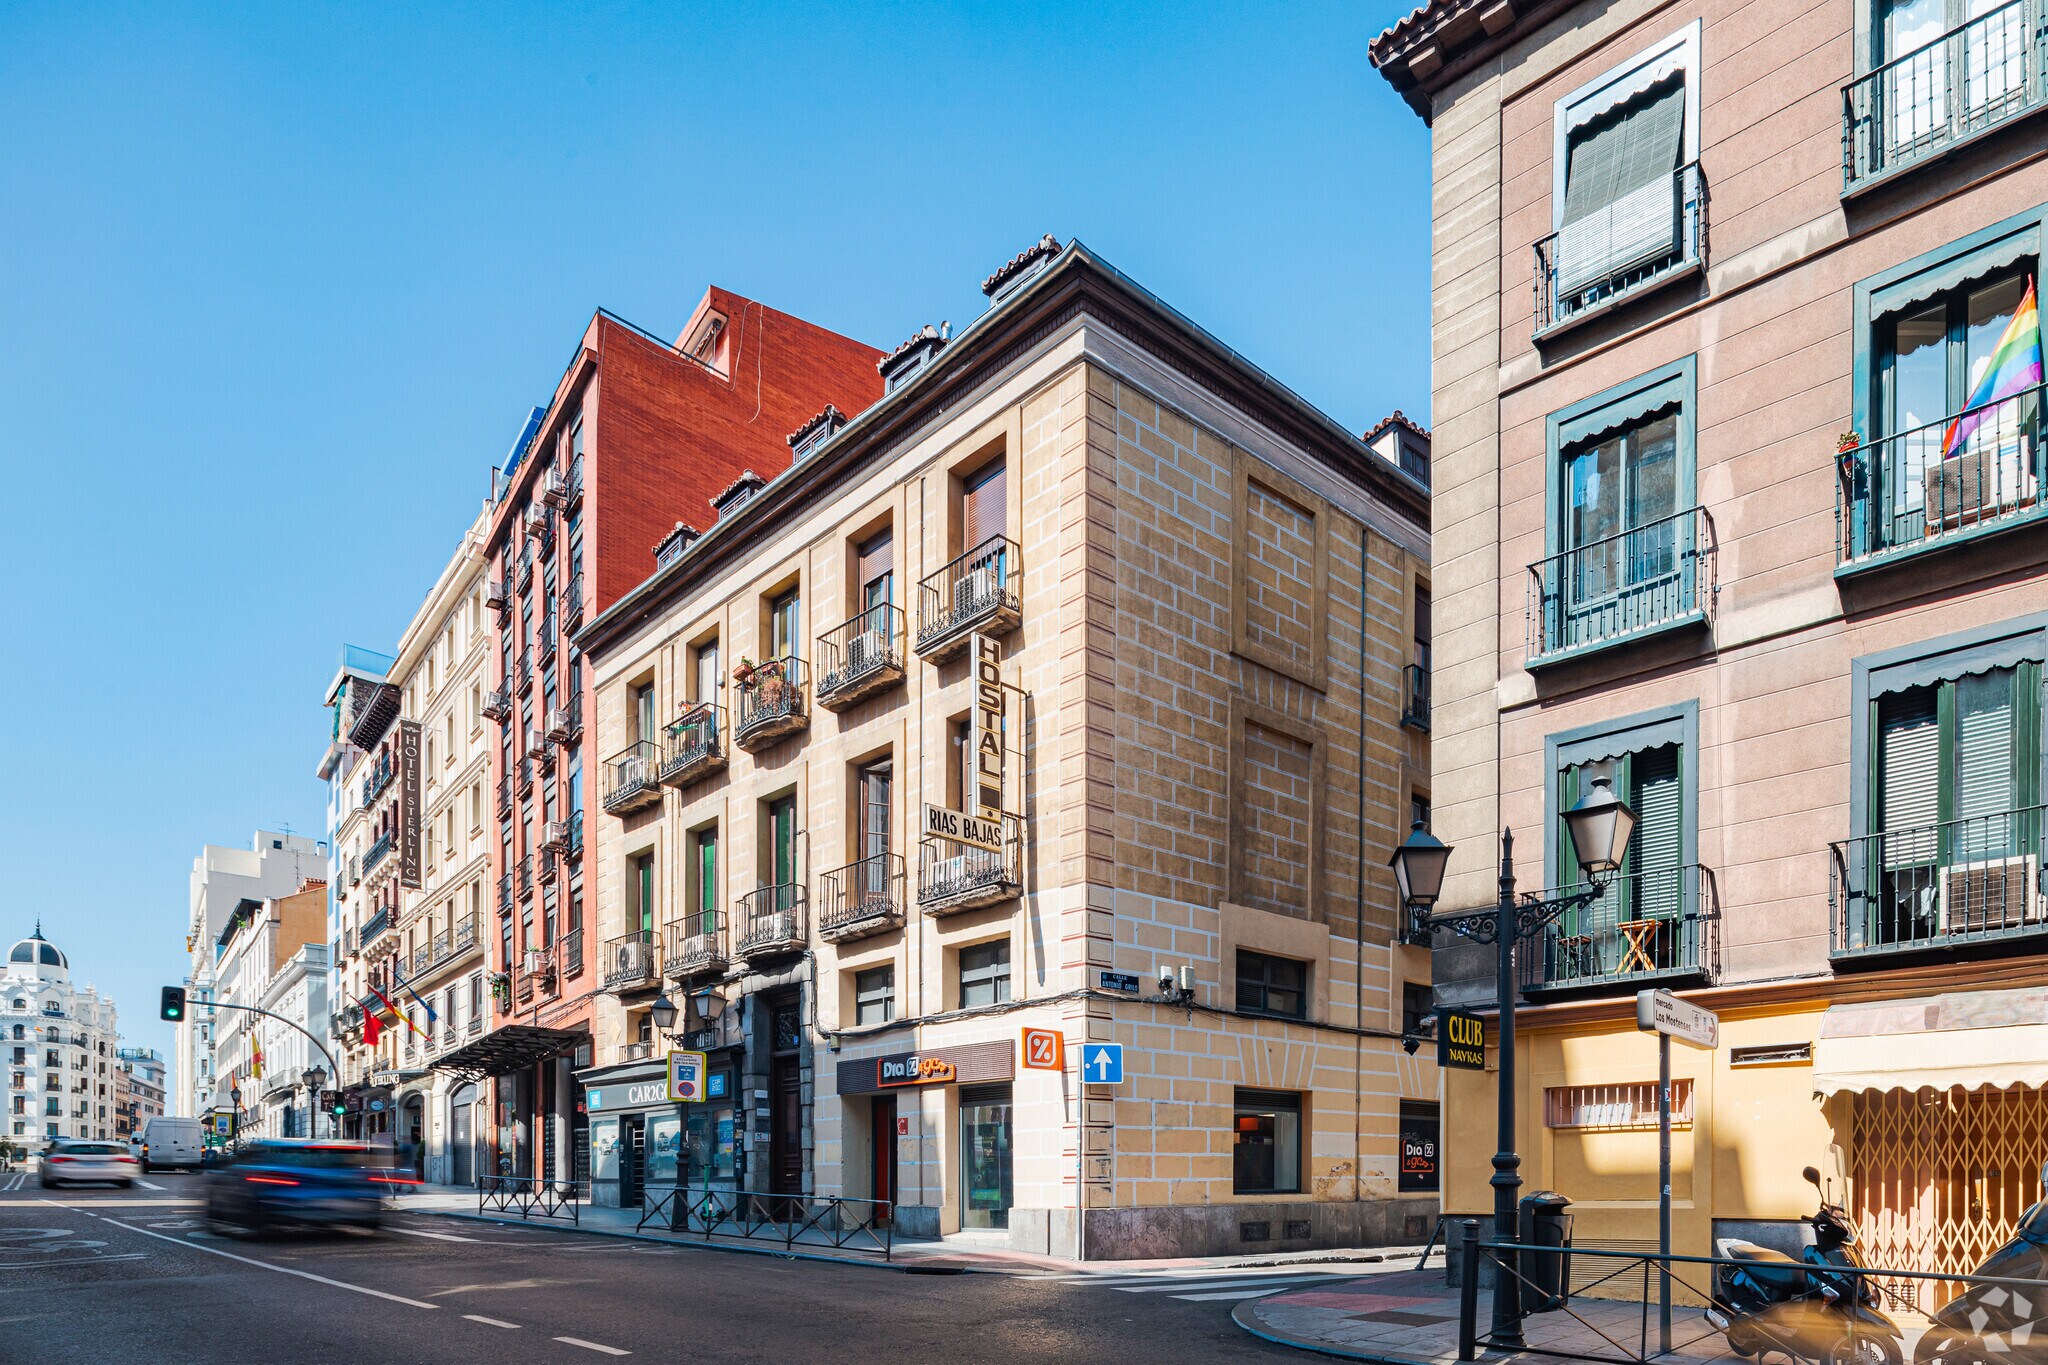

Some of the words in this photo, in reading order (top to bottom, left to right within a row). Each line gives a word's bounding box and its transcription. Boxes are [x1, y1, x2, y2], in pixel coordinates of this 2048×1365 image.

[978, 636, 1000, 778] HOSTAL
[405, 735, 417, 792] HOTEL
[406, 796, 417, 877] STERLING
[929, 808, 957, 835] RIAS
[963, 818, 1001, 847] BAJAS
[1101, 980, 1122, 989] ANTONIO
[1124, 983, 1138, 991] GRILO
[1655, 998, 1673, 1011] mercado
[1449, 1015, 1483, 1046] CLUB
[1655, 1009, 1665, 1022] Los
[1665, 1014, 1691, 1032] Mostenses
[1449, 1048, 1483, 1065] NAYKAS
